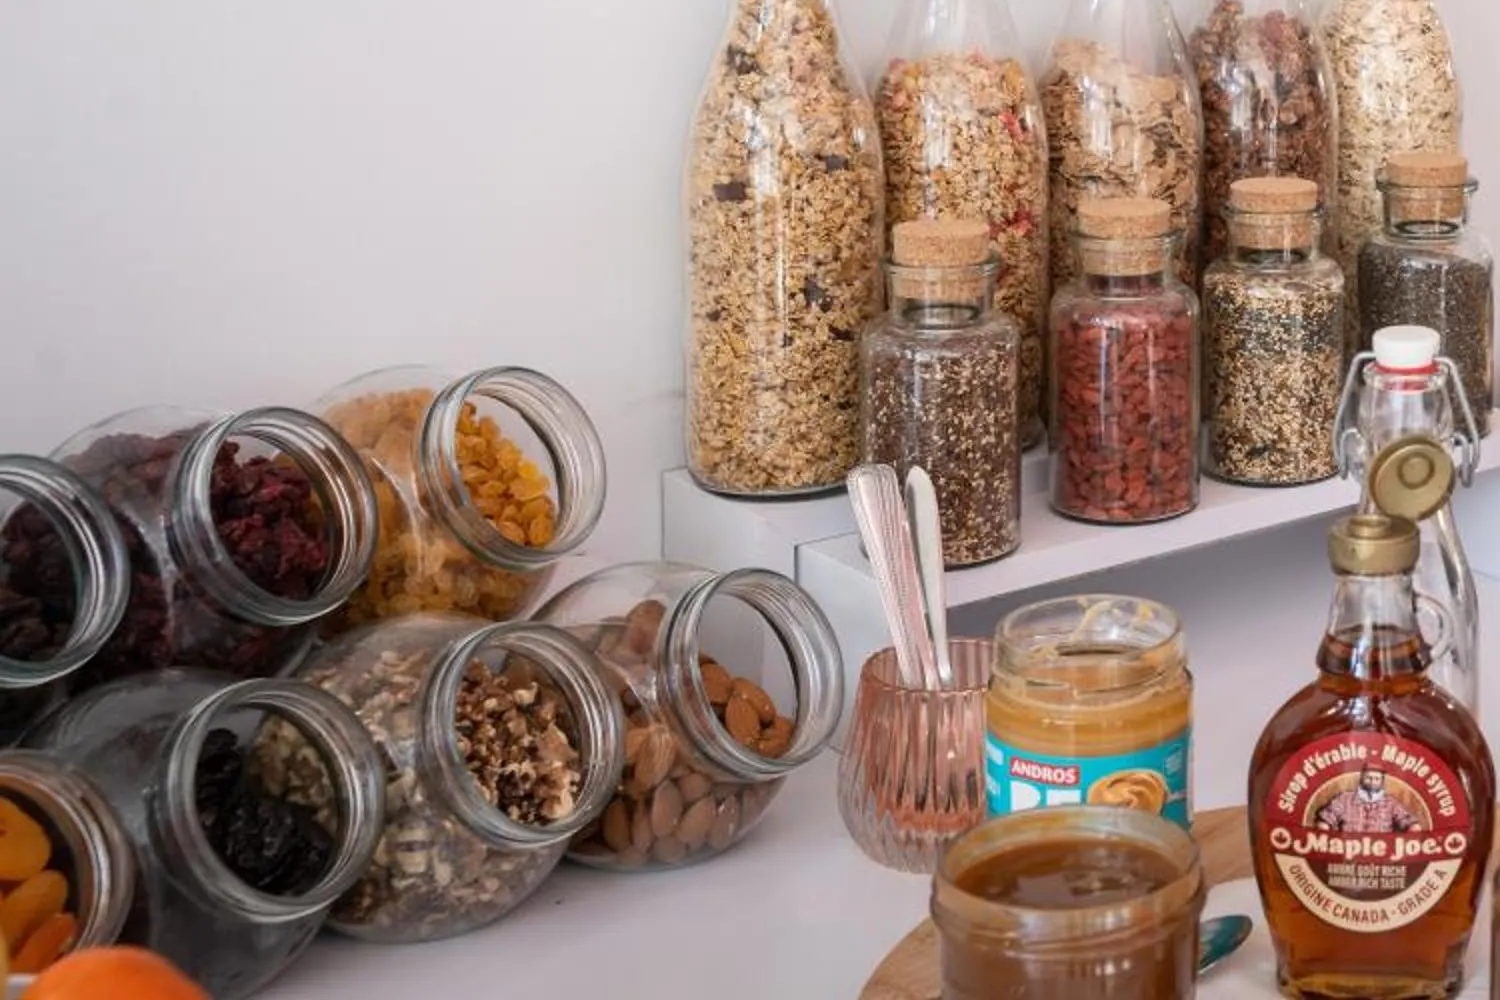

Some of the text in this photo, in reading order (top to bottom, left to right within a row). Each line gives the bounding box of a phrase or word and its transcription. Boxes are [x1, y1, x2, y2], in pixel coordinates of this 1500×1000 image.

[1011, 760, 1077, 785] ANDROS
[1278, 772, 1311, 813] Sirop
[1303, 742, 1367, 778] d'érable
[1381, 744, 1430, 777] Maple
[1293, 831, 1387, 860] Maple
[1288, 864, 1332, 913] ORIGINE
[1332, 902, 1390, 924] CANADA
[1397, 880, 1439, 916] GRADE
[1437, 869, 1448, 883] A
